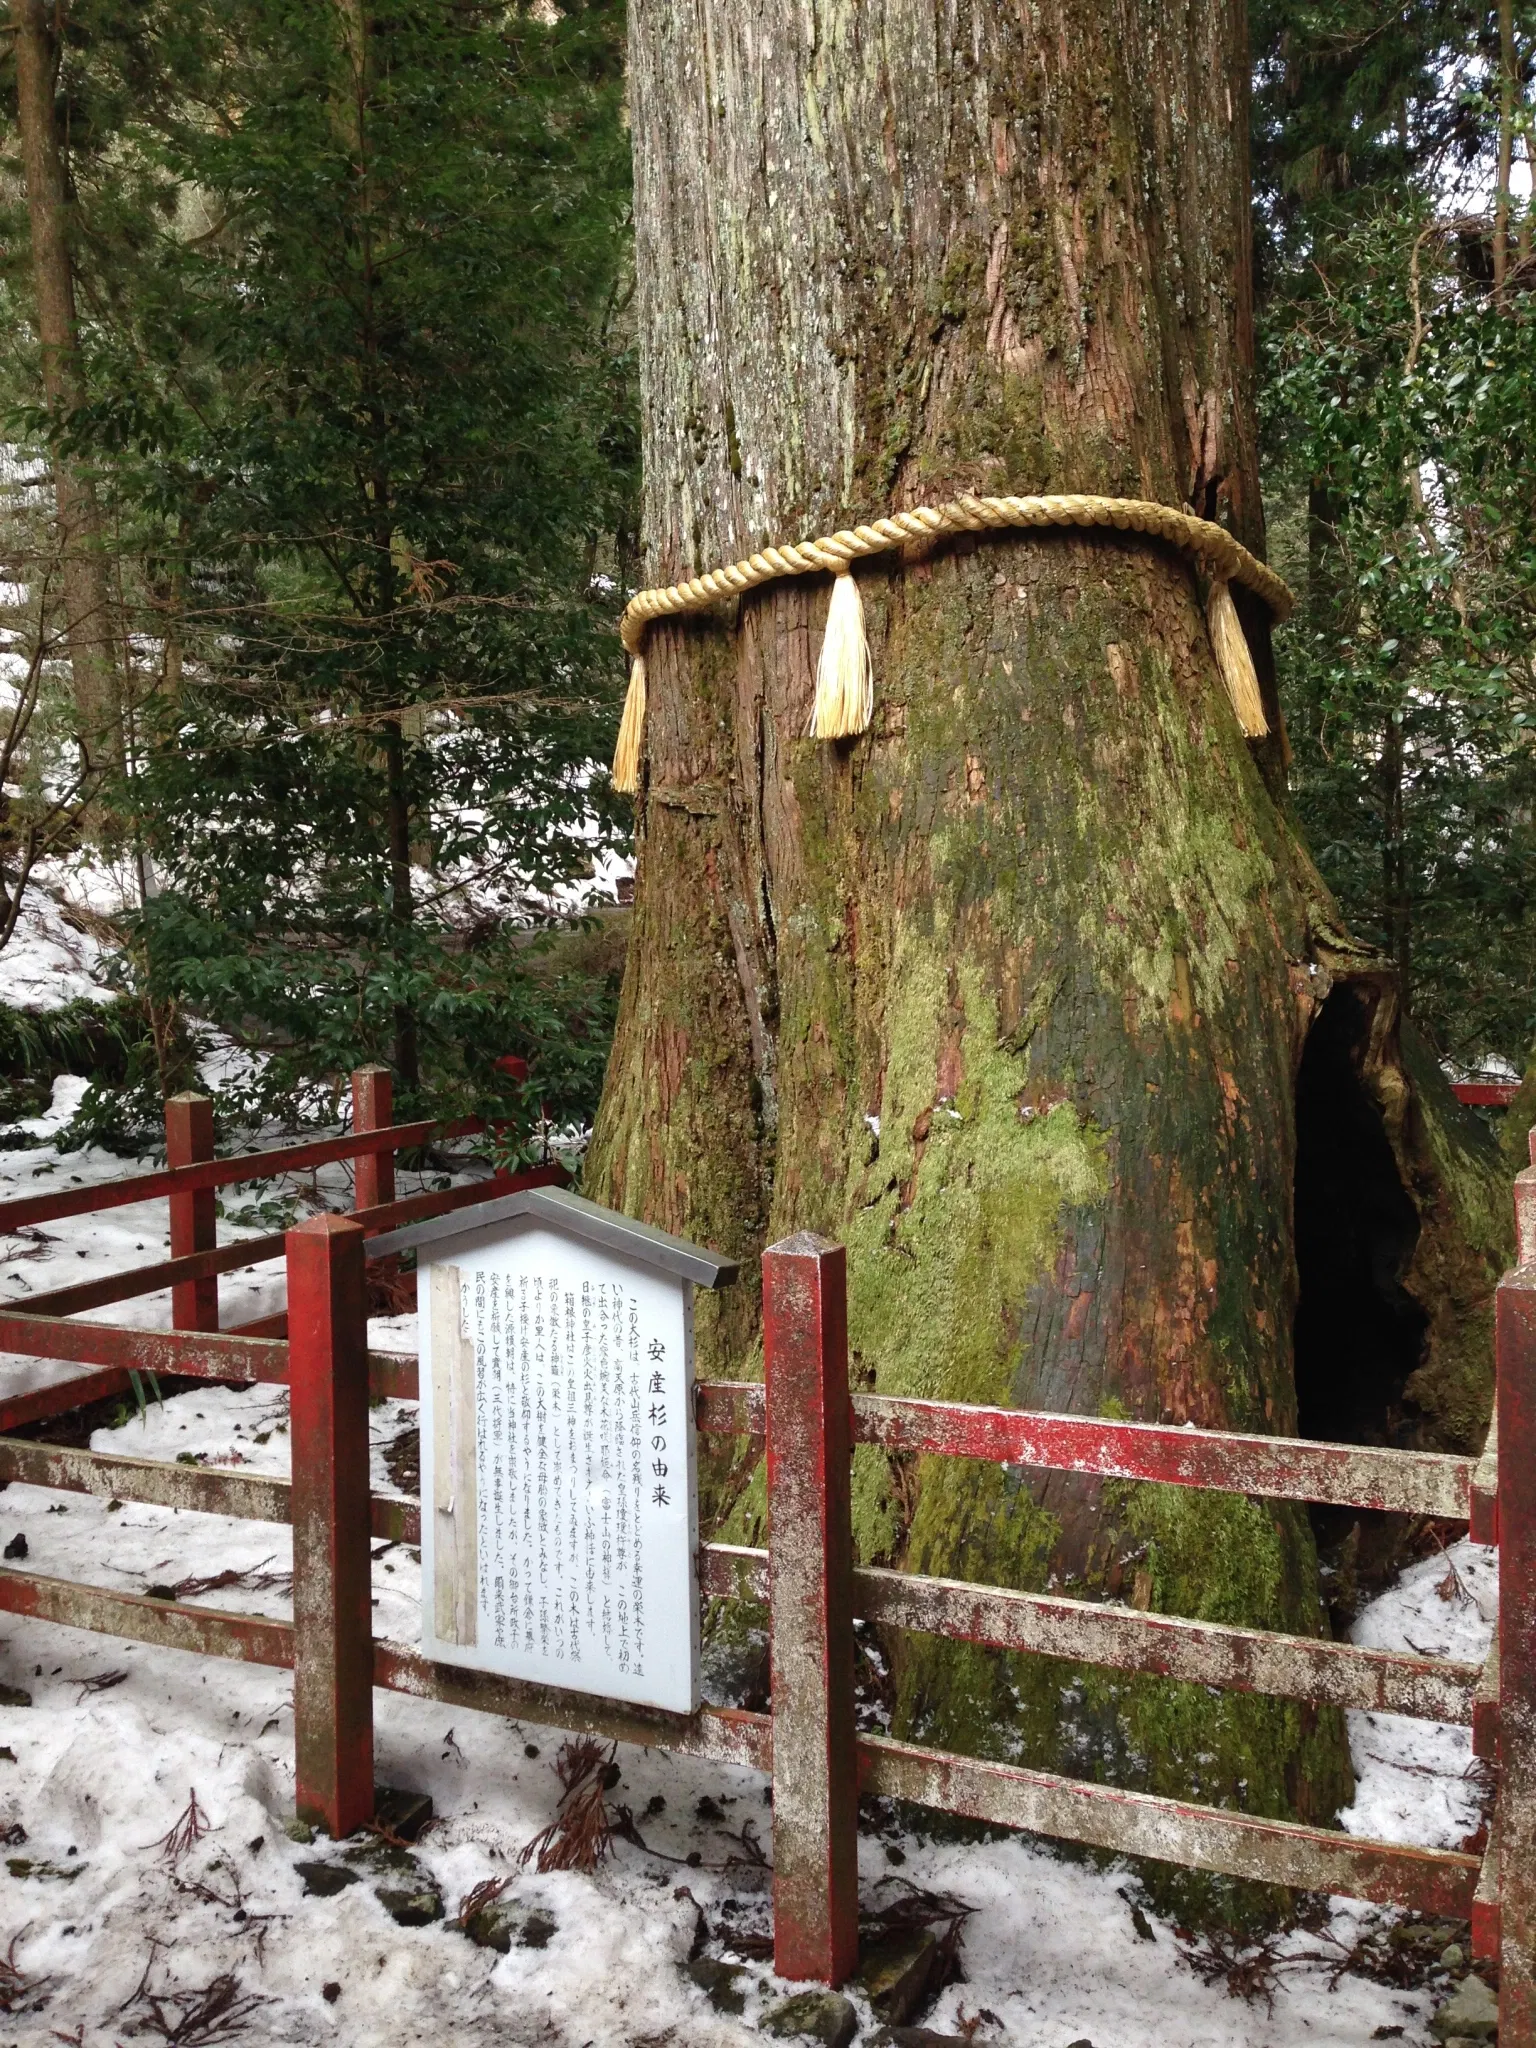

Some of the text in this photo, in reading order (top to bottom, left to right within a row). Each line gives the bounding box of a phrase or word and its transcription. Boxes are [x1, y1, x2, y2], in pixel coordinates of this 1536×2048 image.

[647, 1338, 671, 1508] 安産杉の由来
